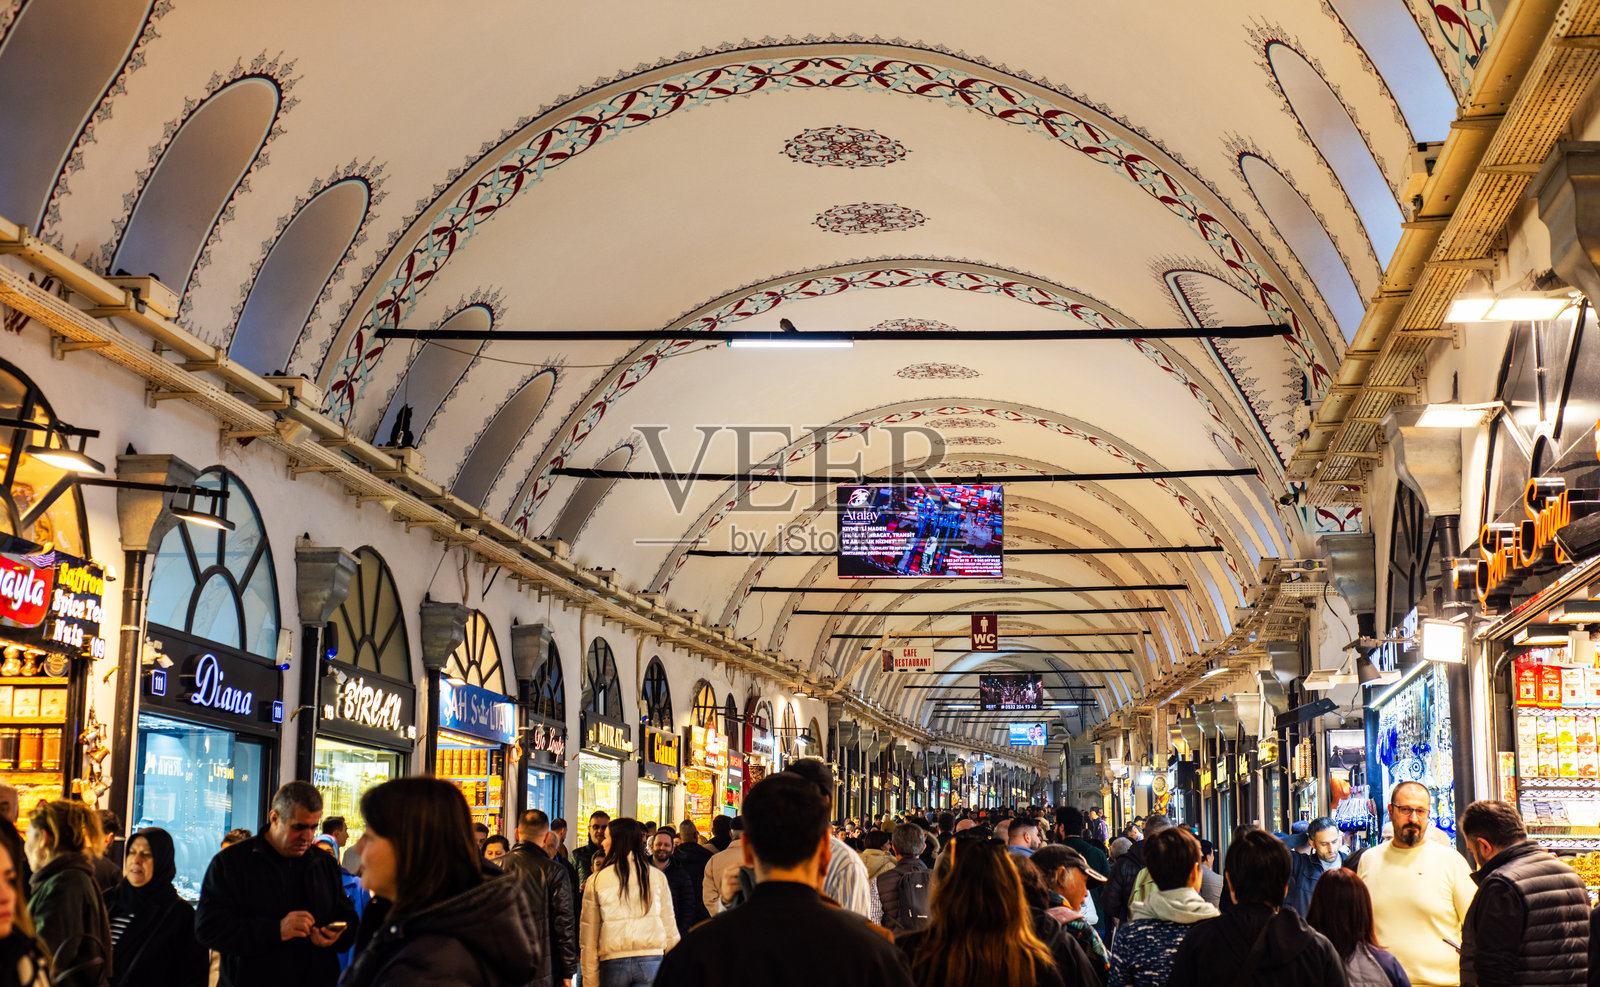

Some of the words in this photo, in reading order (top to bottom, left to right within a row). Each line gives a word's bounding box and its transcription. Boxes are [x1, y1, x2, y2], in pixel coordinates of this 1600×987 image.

[842, 508, 880, 523] Atalay
[0, 568, 45, 611] ayla
[58, 562, 103, 596] Saffron
[52, 588, 85, 618] Spice
[53, 619, 83, 647] Nuts
[974, 633, 996, 644] WC
[894, 658, 931, 667] RESTAURANT
[903, 648, 917, 658] CAFE
[191, 653, 252, 715] Diana
[599, 721, 623, 749] MURAT
